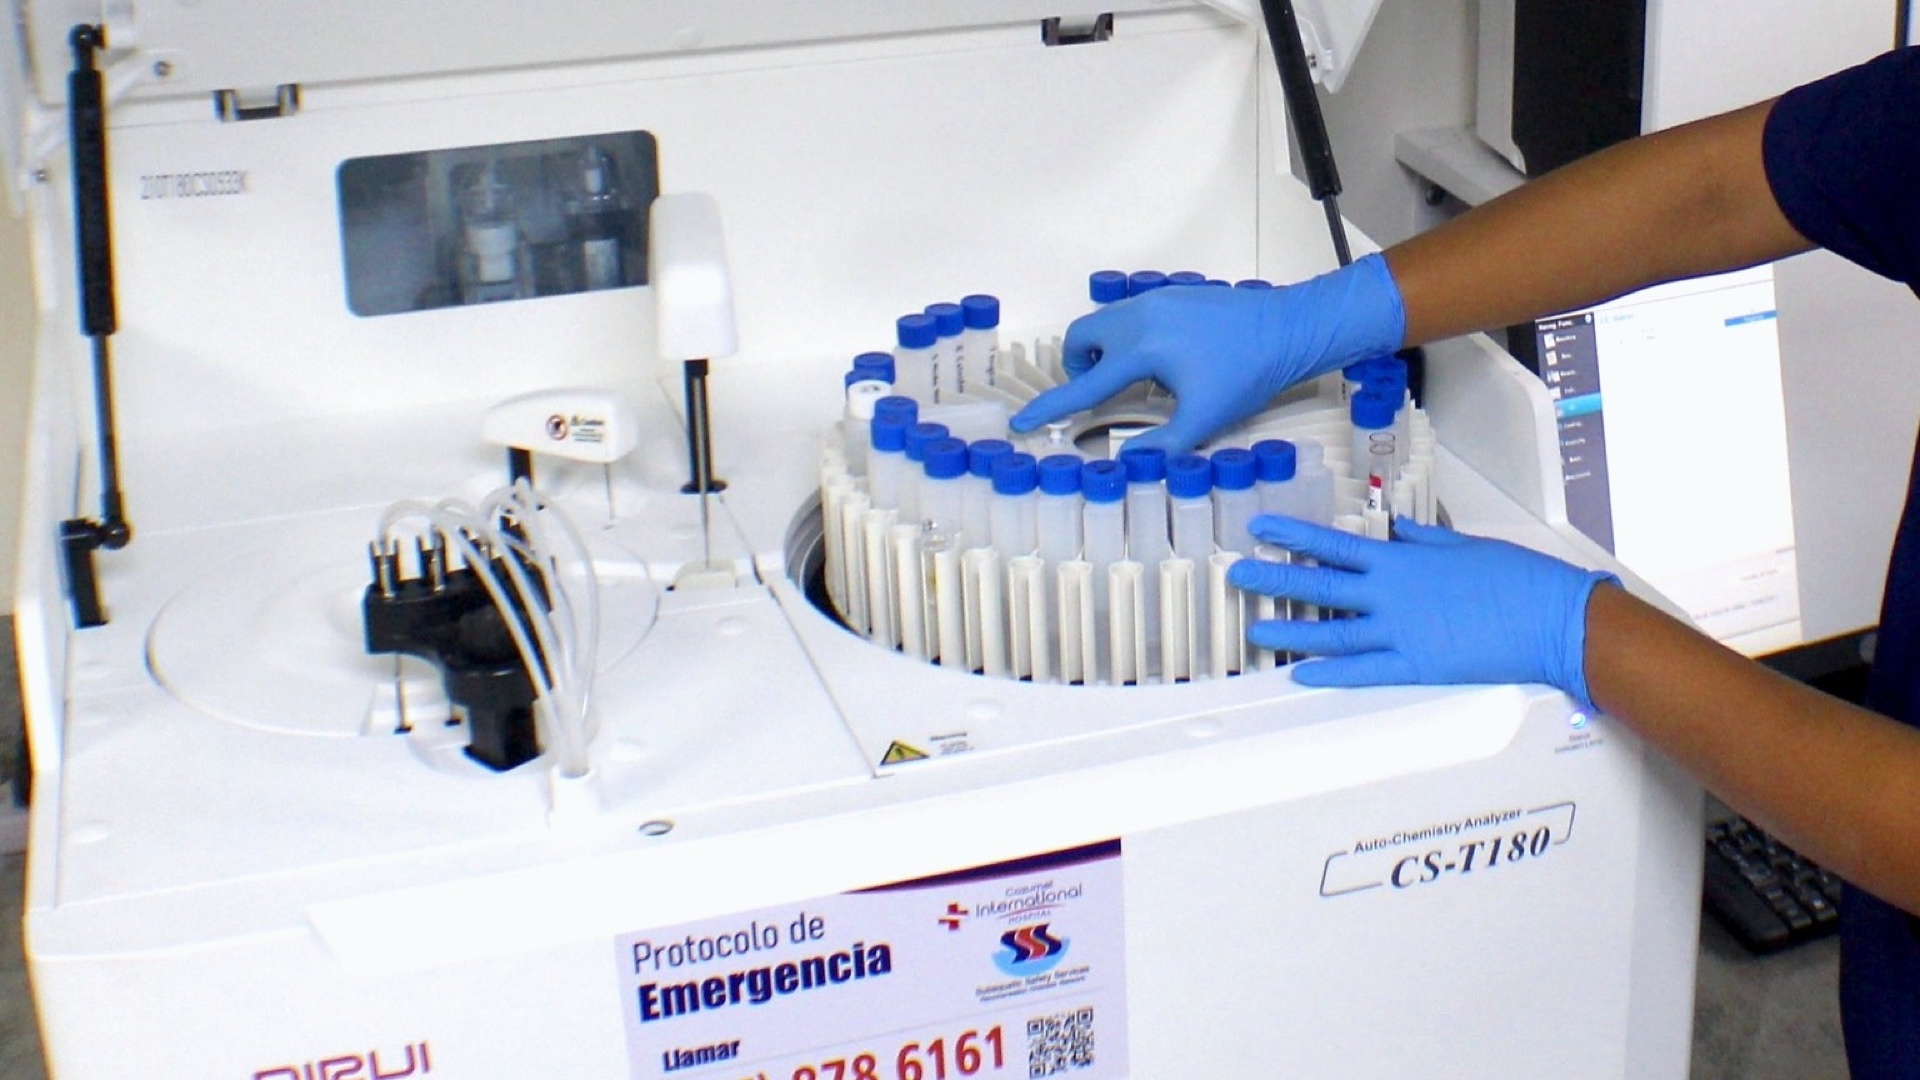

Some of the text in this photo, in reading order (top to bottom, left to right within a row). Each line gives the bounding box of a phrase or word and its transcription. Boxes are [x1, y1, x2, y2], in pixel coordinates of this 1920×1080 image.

[1354, 808, 1522, 853] Auto-Chemistry Analyzer
[1391, 825, 1551, 889] CS-T180
[975, 882, 1082, 917] International
[633, 912, 825, 974] Protocolo de
[637, 942, 892, 1023] Emergencia
[662, 1039, 741, 1072] Llamar
[895, 1025, 1003, 1080] 6161
